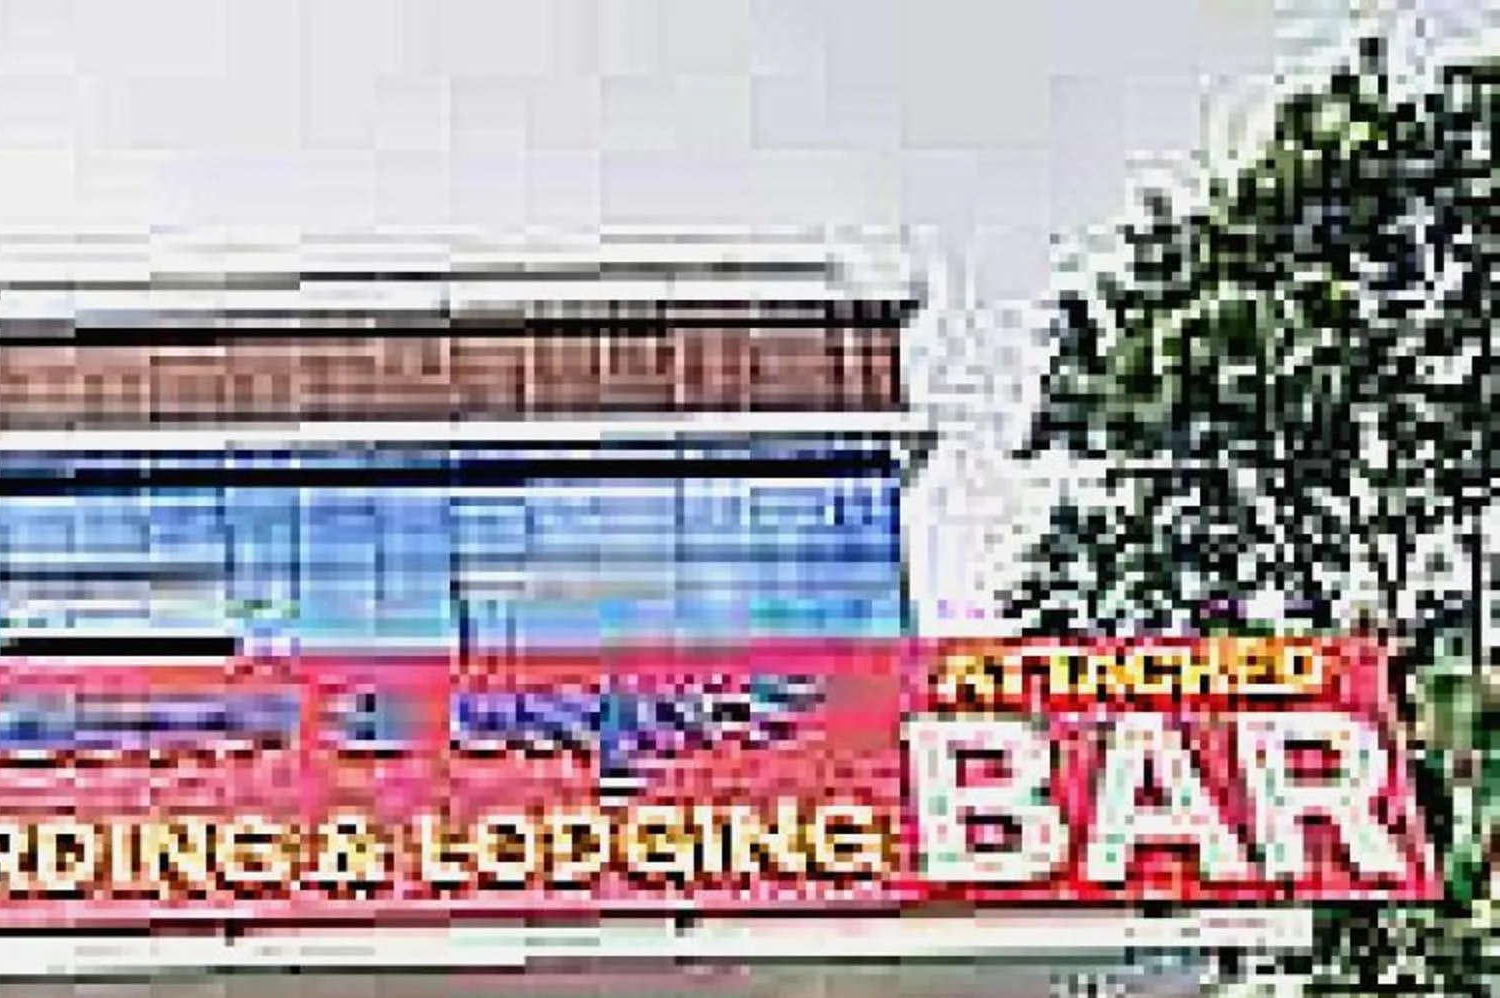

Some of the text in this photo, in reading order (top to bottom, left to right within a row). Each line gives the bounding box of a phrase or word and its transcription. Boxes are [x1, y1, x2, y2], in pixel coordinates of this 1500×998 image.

[934, 644, 1330, 706] ATTACHED
[902, 712, 1412, 884] BAR
[308, 818, 388, 892] &
[416, 804, 896, 888] LODGING
